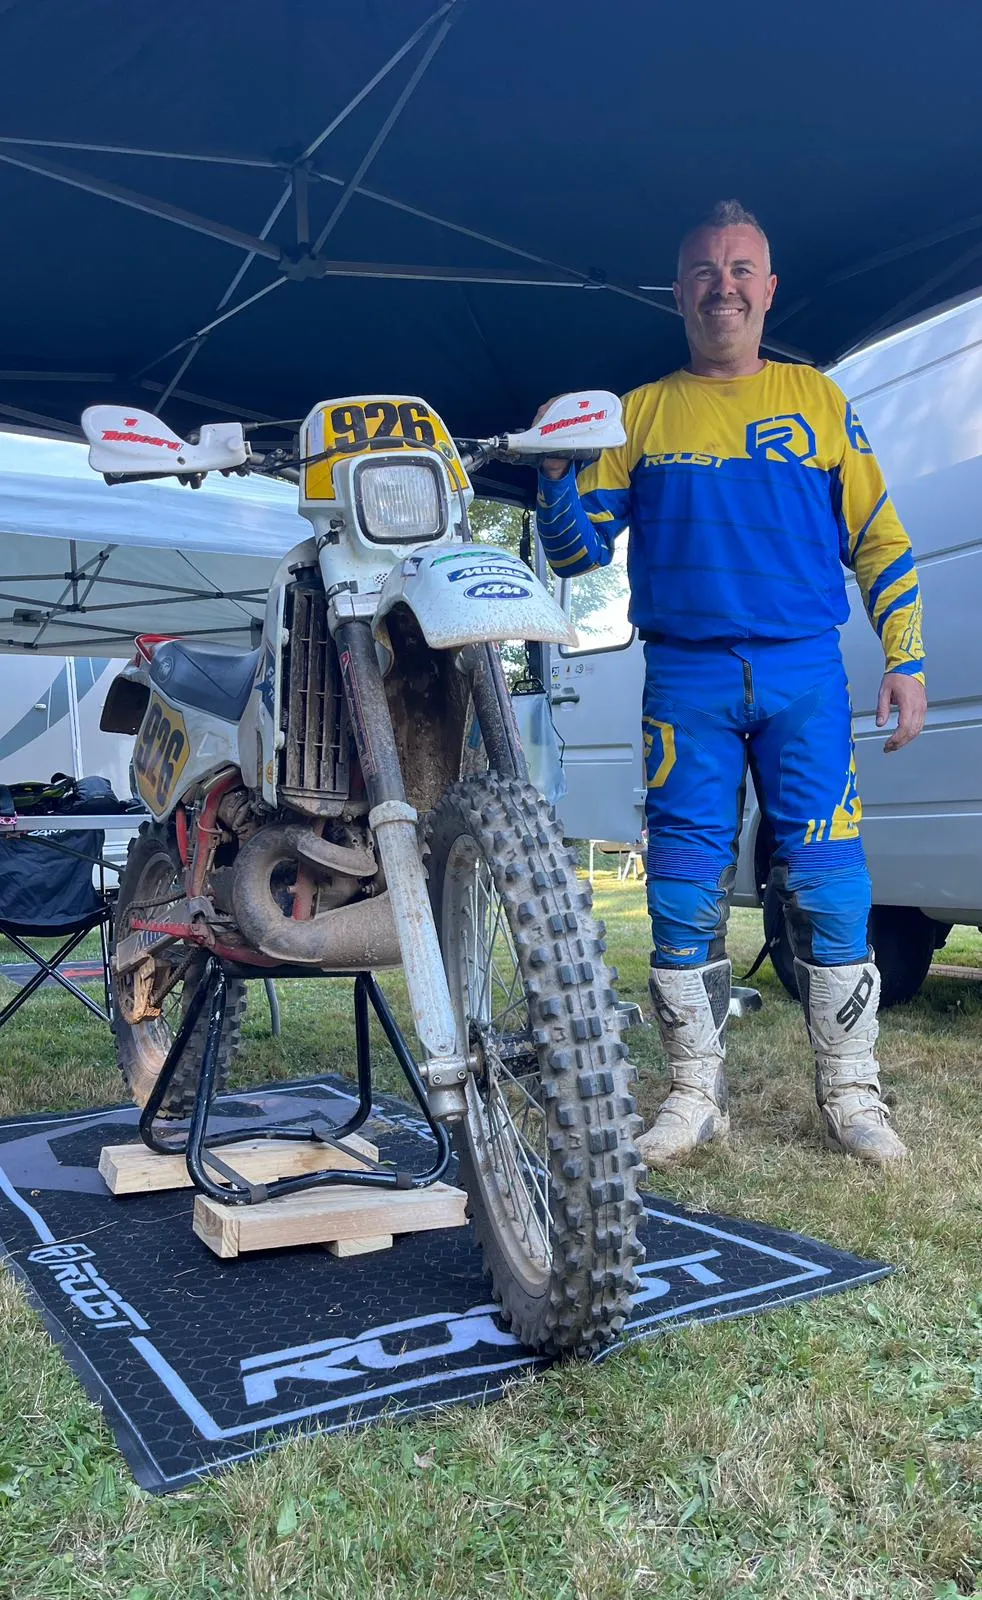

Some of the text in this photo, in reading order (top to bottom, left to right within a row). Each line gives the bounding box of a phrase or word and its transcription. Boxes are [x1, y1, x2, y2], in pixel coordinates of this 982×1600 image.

[331, 402, 436, 453] 926
[643, 450, 730, 468] ROOST
[474, 584, 521, 597] KTM
[136, 702, 184, 807] 926
[48, 1262, 151, 1331] ROOST
